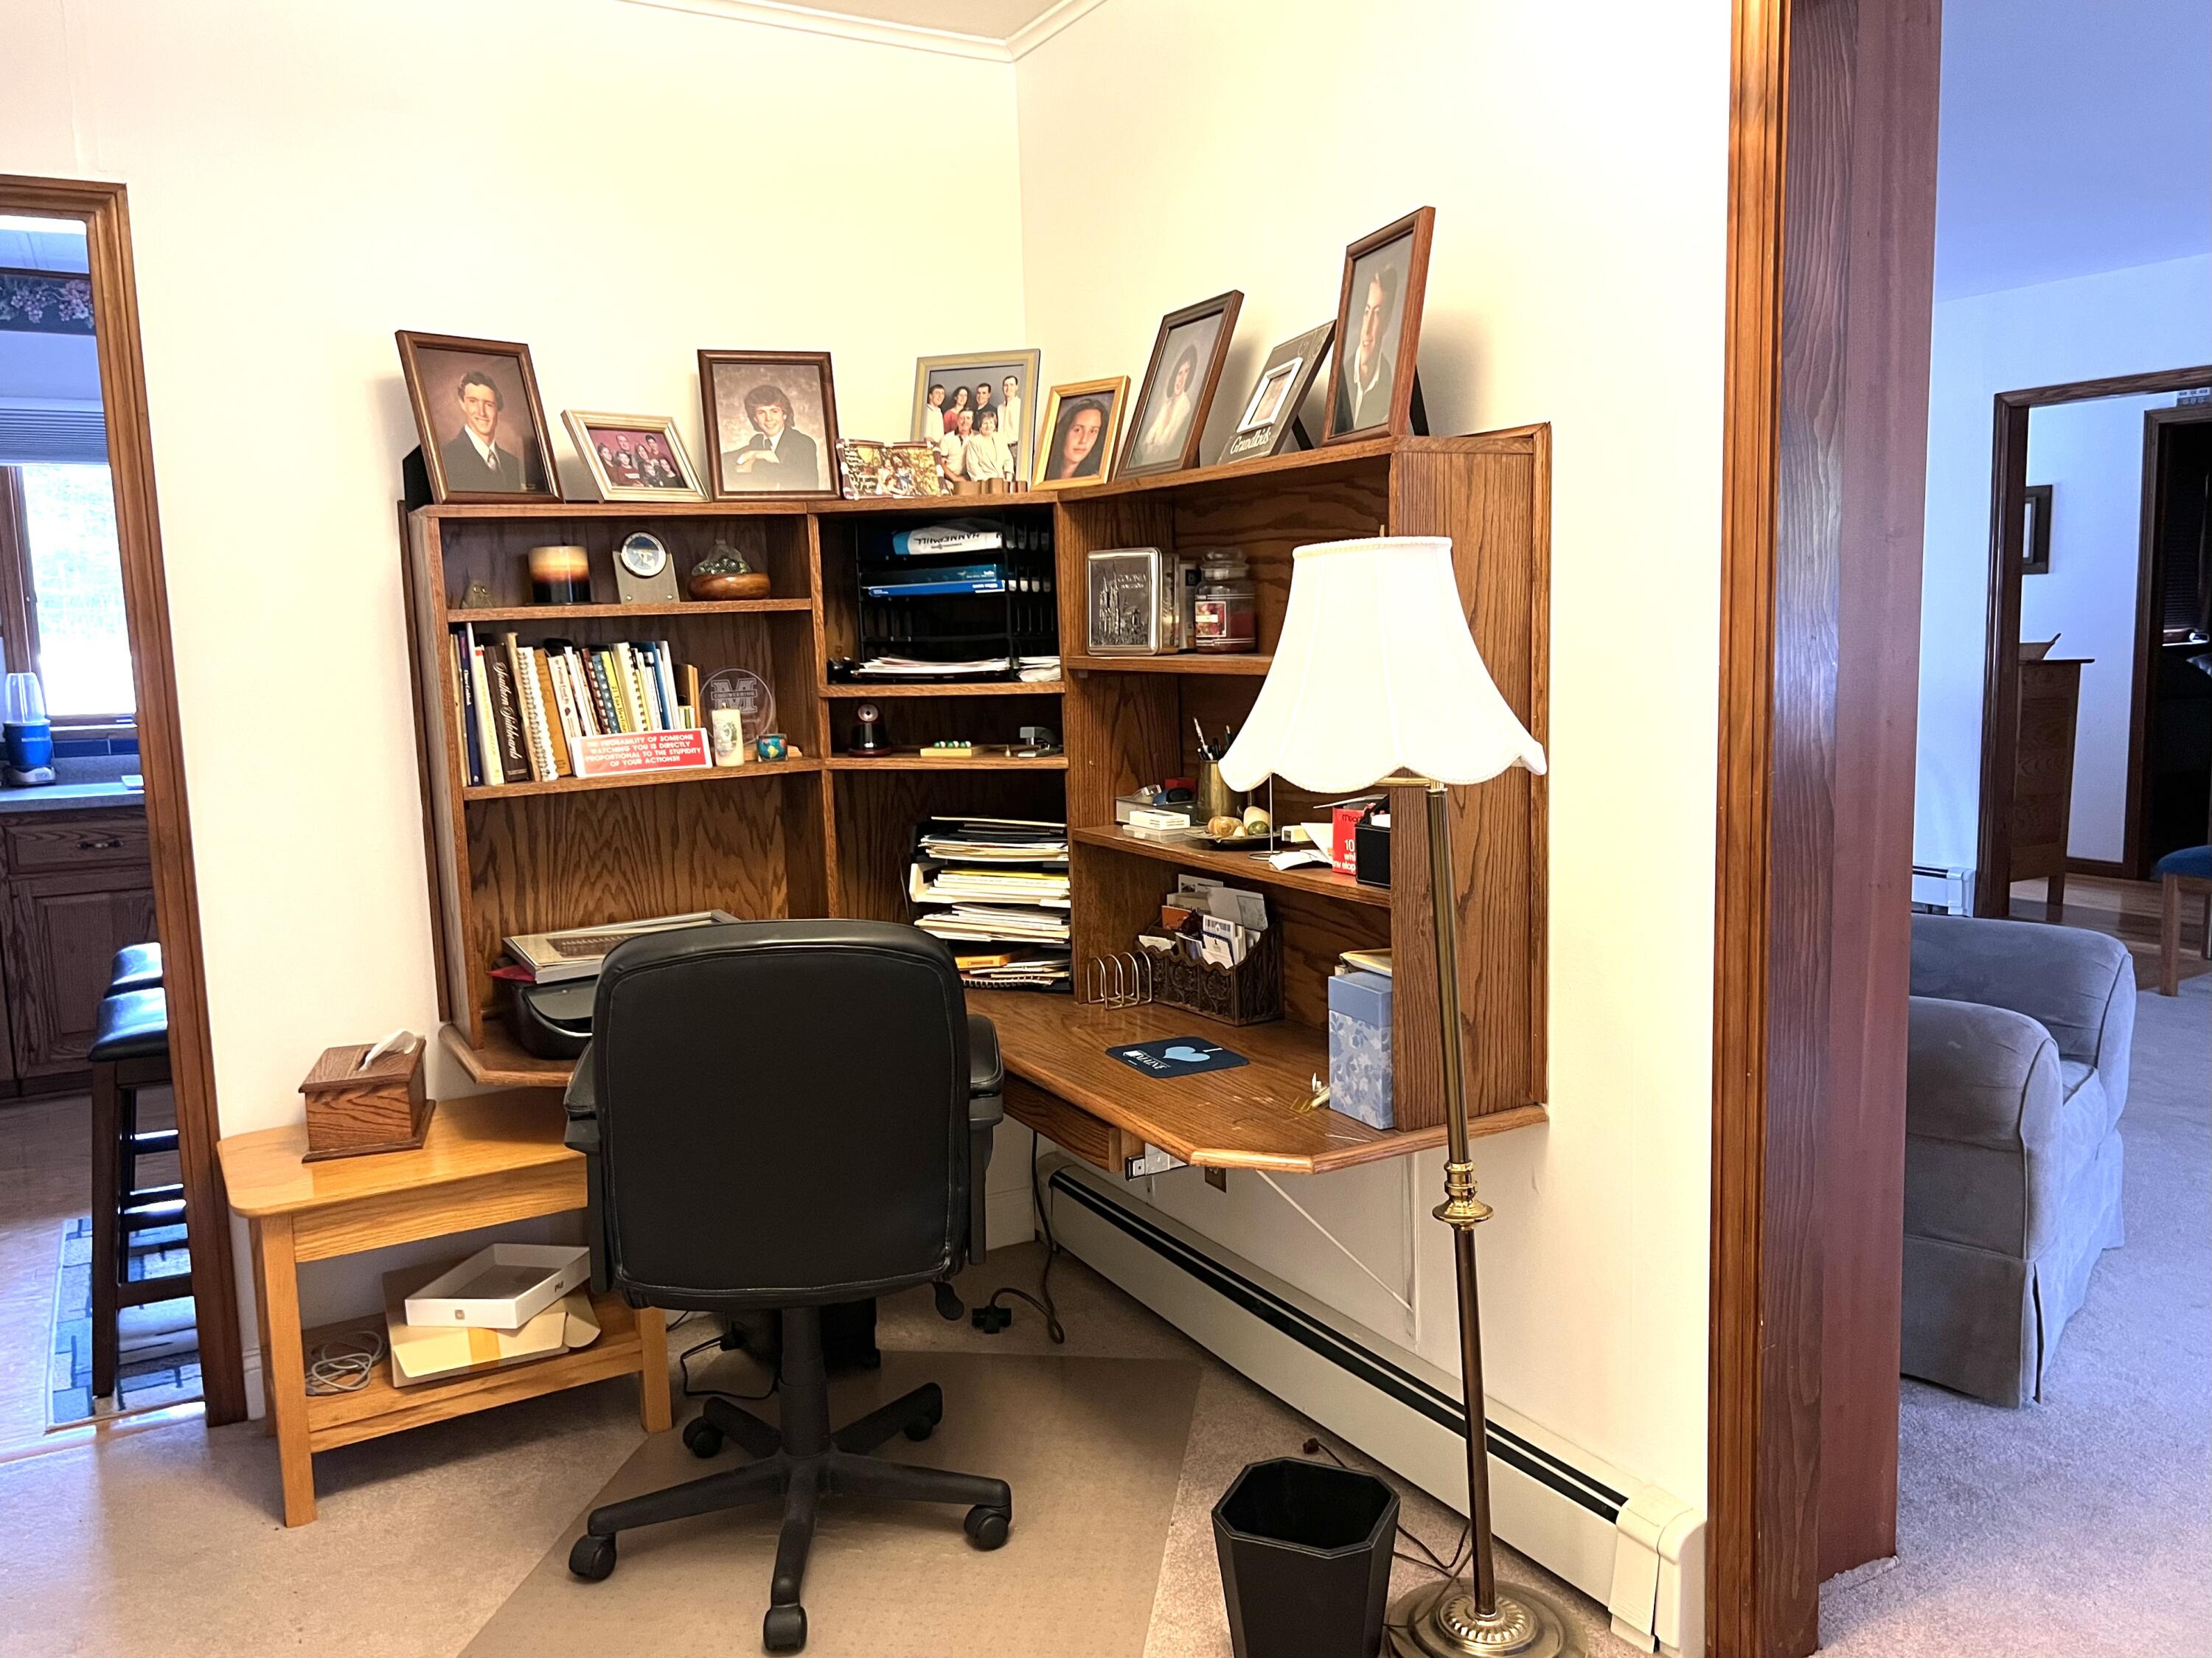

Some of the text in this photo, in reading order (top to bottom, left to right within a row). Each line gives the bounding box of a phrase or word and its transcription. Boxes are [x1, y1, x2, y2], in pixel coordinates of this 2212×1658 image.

[493, 662, 512, 706] Southern
[591, 745, 630, 754] WATCHING
[586, 752, 640, 762] PROPORTIONAL
[1343, 852, 1356, 862] whi
